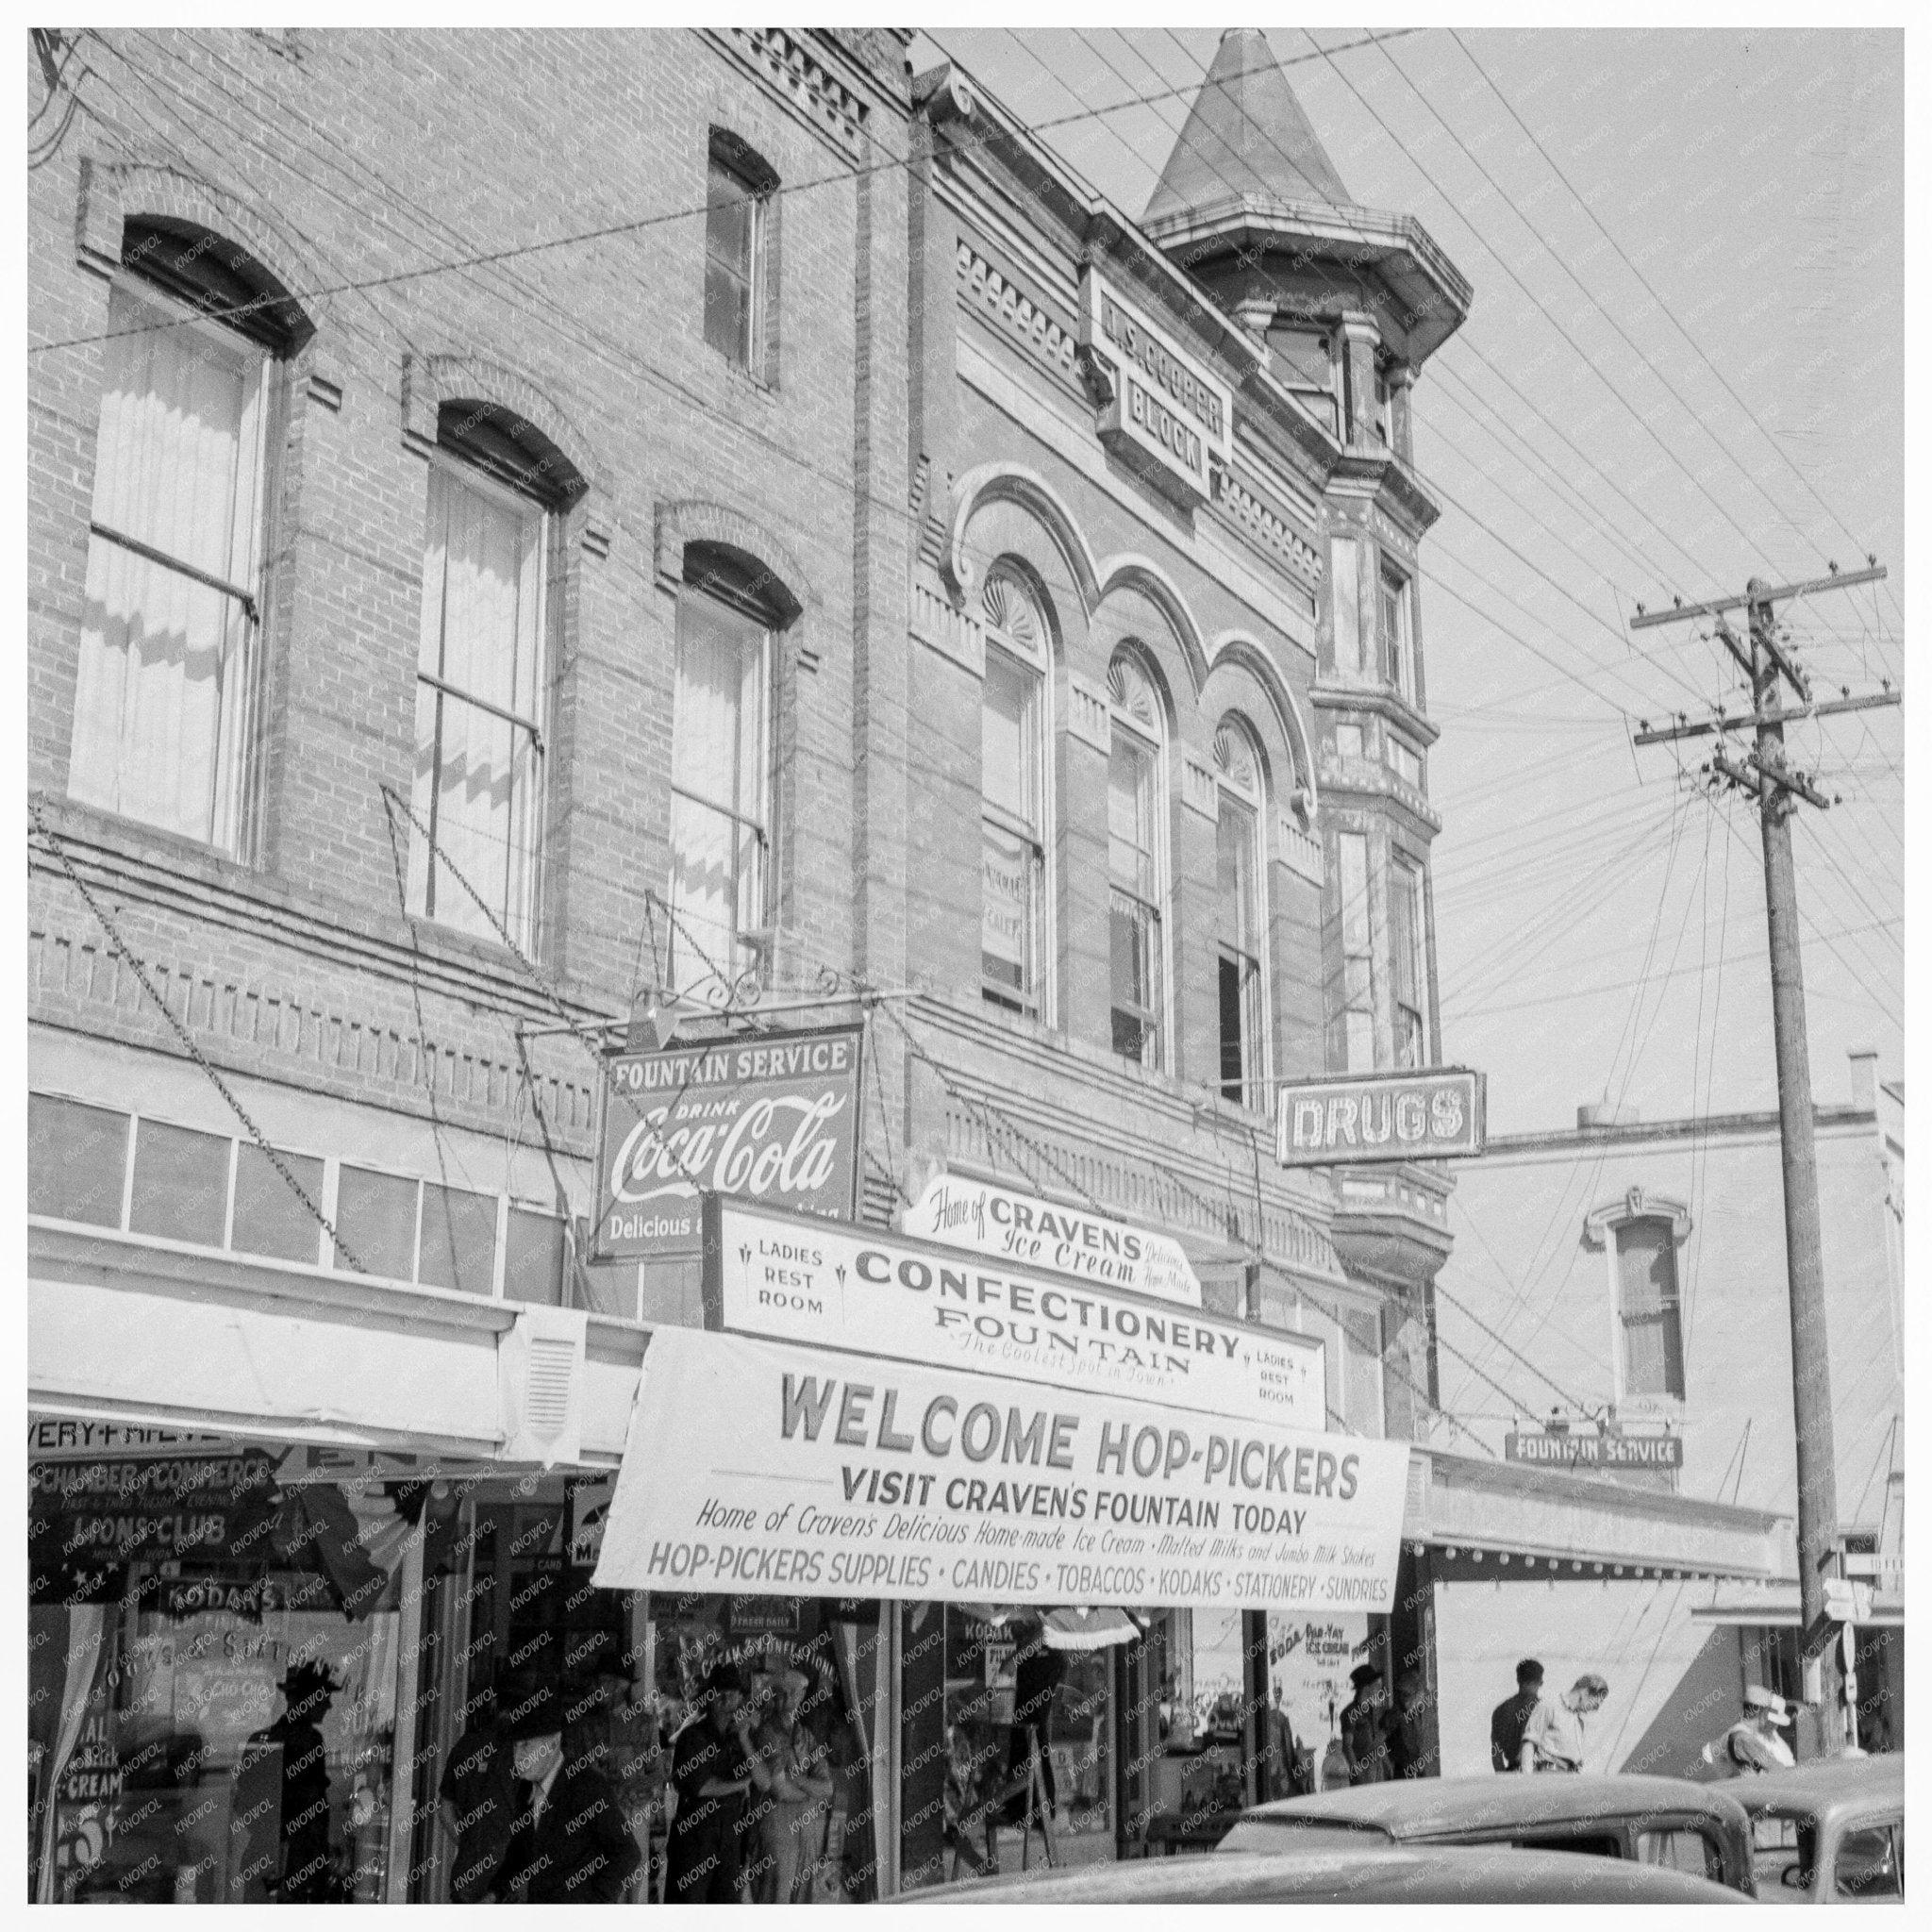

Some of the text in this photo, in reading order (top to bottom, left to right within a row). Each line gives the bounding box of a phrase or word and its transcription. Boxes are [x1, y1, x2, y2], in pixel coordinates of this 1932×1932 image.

[1132, 383, 1198, 472] BLOCK
[615, 1041, 849, 1090] FOUNTAIN SERVICE
[675, 1099, 741, 1121] DRINK
[1293, 1089, 1463, 1147] DRUGS
[609, 1214, 691, 1240] Delicious
[930, 1185, 970, 1233] Home
[971, 1191, 986, 1240] of
[758, 1239, 824, 1267] LADIES
[1001, 1229, 1136, 1283] Ice Cream
[764, 1266, 814, 1290] REST
[758, 1289, 824, 1314] ROOM
[855, 1250, 1240, 1359] CONFECTIONERY
[933, 1306, 1191, 1375] FOUNTAIN
[1257, 1350, 1294, 1371] LADIES
[1260, 1371, 1290, 1387] REST
[1258, 1388, 1294, 1406] ROOM
[780, 1372, 1361, 1502] WELCOME HOP-PICKERS
[1606, 1439, 1675, 1463] SERVICE
[40, 1463, 138, 1495] CHAMBER
[152, 1457, 272, 1491] COMMERCE
[841, 1465, 1307, 1536] VISIT CRAVEN'S FOUNTAIN TODAY
[72, 1512, 227, 1546] LIONS CLUB
[696, 1498, 1375, 1568] Home of Craven's Delicious Home-made Ice Cream Malted Milks and Jumbo Milk Shakes
[646, 1541, 1389, 1603] HOP-PICKERS SUPPLIES CANDIES TOBACCOS KODAKS STATIONERY SUNDRIES
[964, 1623, 1013, 1641] KODAK
[1269, 1629, 1301, 1666] SODA
